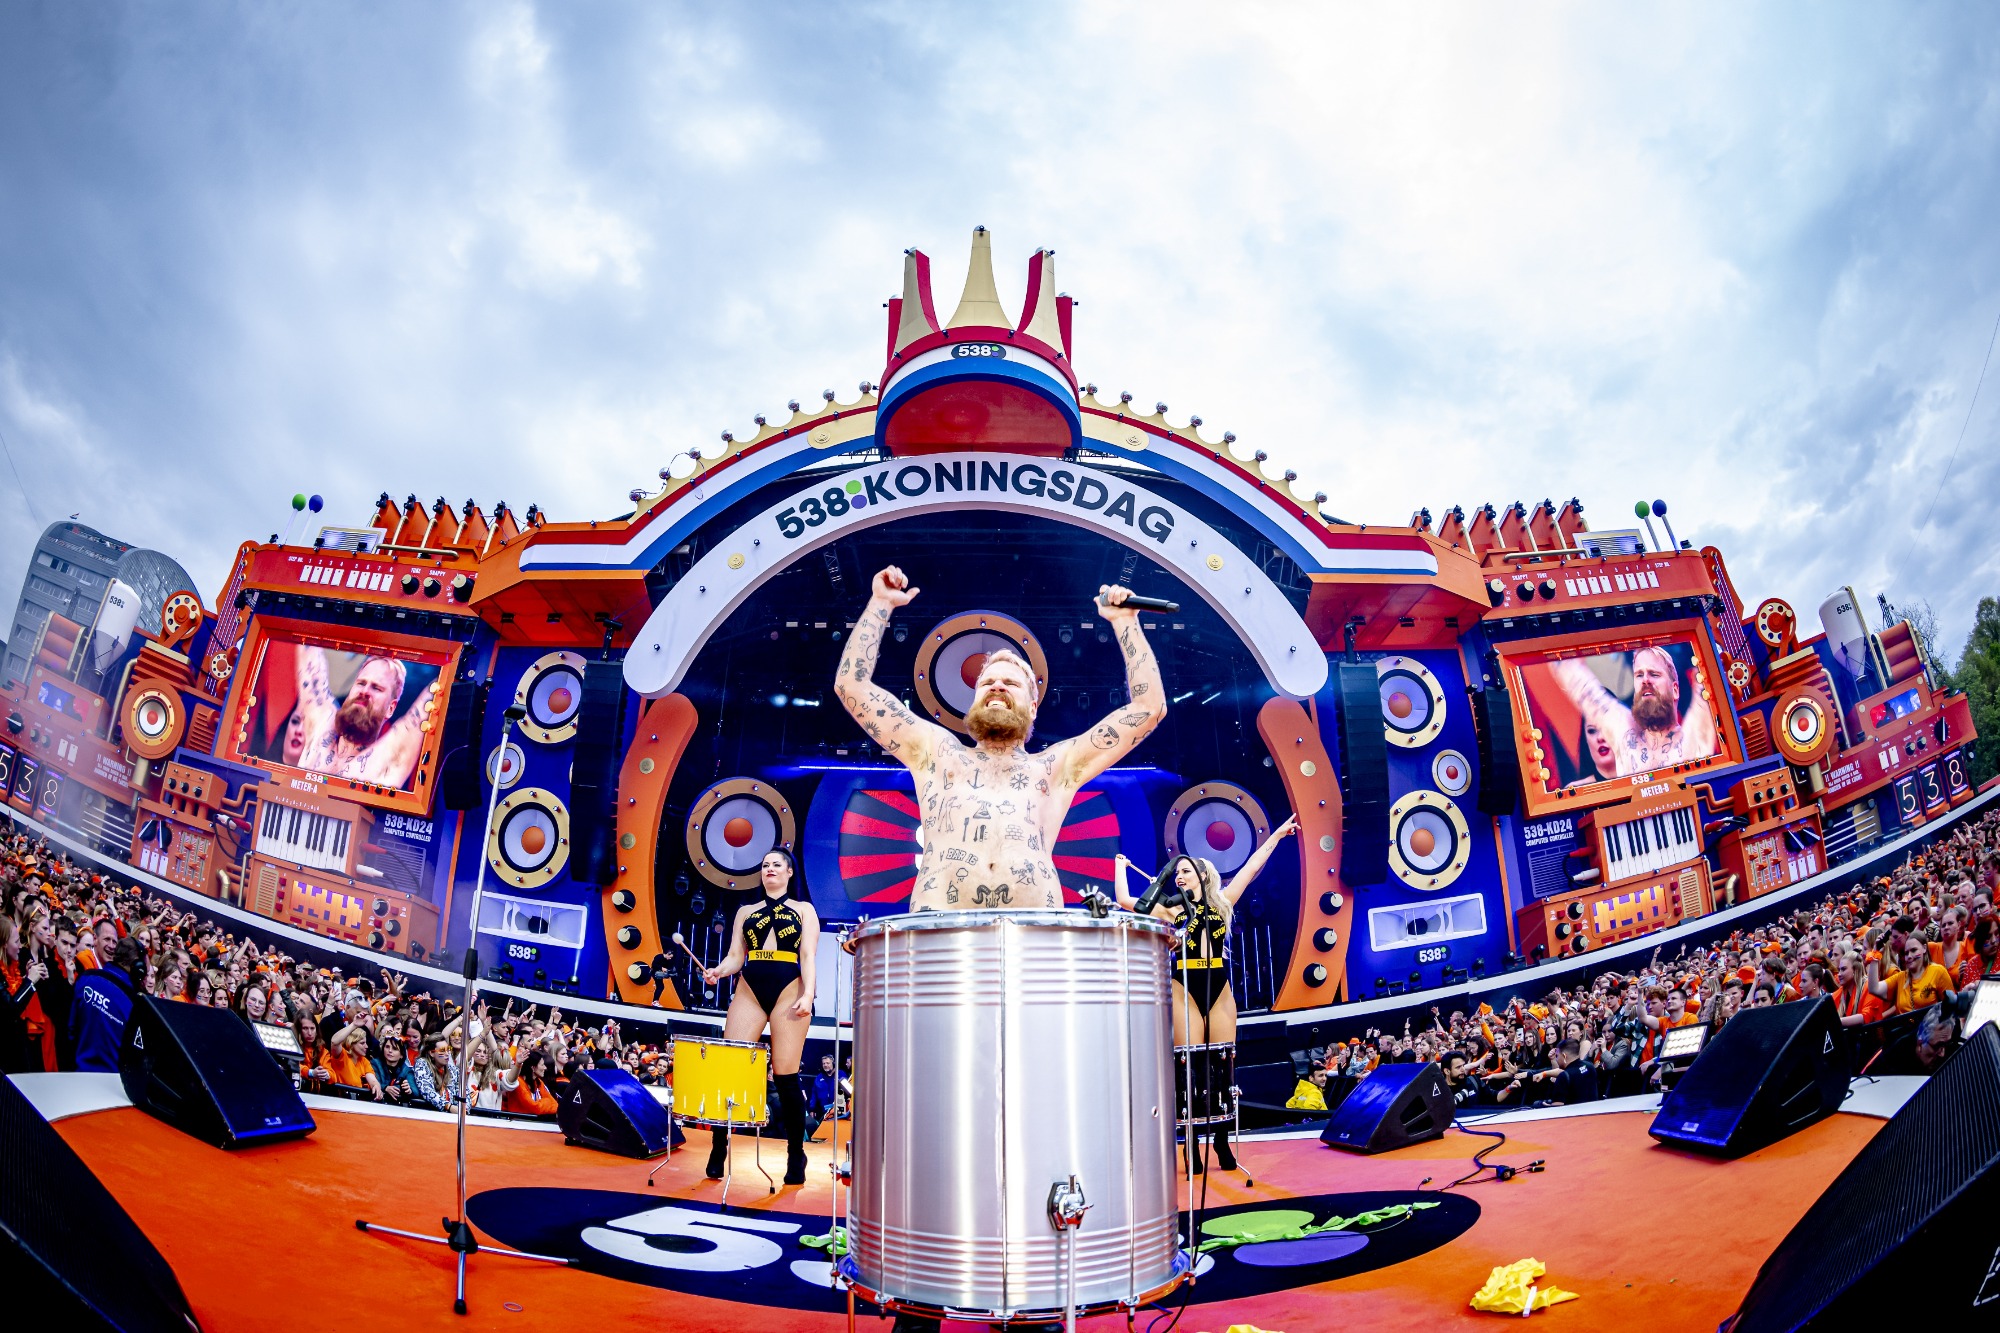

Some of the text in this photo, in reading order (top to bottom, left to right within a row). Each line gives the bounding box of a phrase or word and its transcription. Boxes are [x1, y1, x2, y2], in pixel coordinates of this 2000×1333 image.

[958, 344, 992, 357] 538
[775, 460, 1176, 544] 538 KONINGSDAG
[109, 596, 122, 606] 538
[1836, 603, 1850, 614] 538
[304, 772, 324, 784] 538
[1830, 762, 1854, 780] WARNING
[290, 778, 318, 794] METER-A
[1631, 774, 1650, 785] 538
[1902, 759, 1963, 813] 538
[384, 814, 434, 835] 538-KD24
[1524, 818, 1572, 840] 538-KD24
[383, 826, 432, 842] COMPUTER CONTROLLED
[1526, 832, 1574, 846] COMPUTER CONTROLLED
[946, 848, 978, 866] BAR 16
[778, 924, 797, 938] STUK
[508, 944, 531, 960] 538
[755, 951, 774, 960] STUK
[1419, 948, 1442, 962] 538
[94, 990, 110, 1010] TSC
